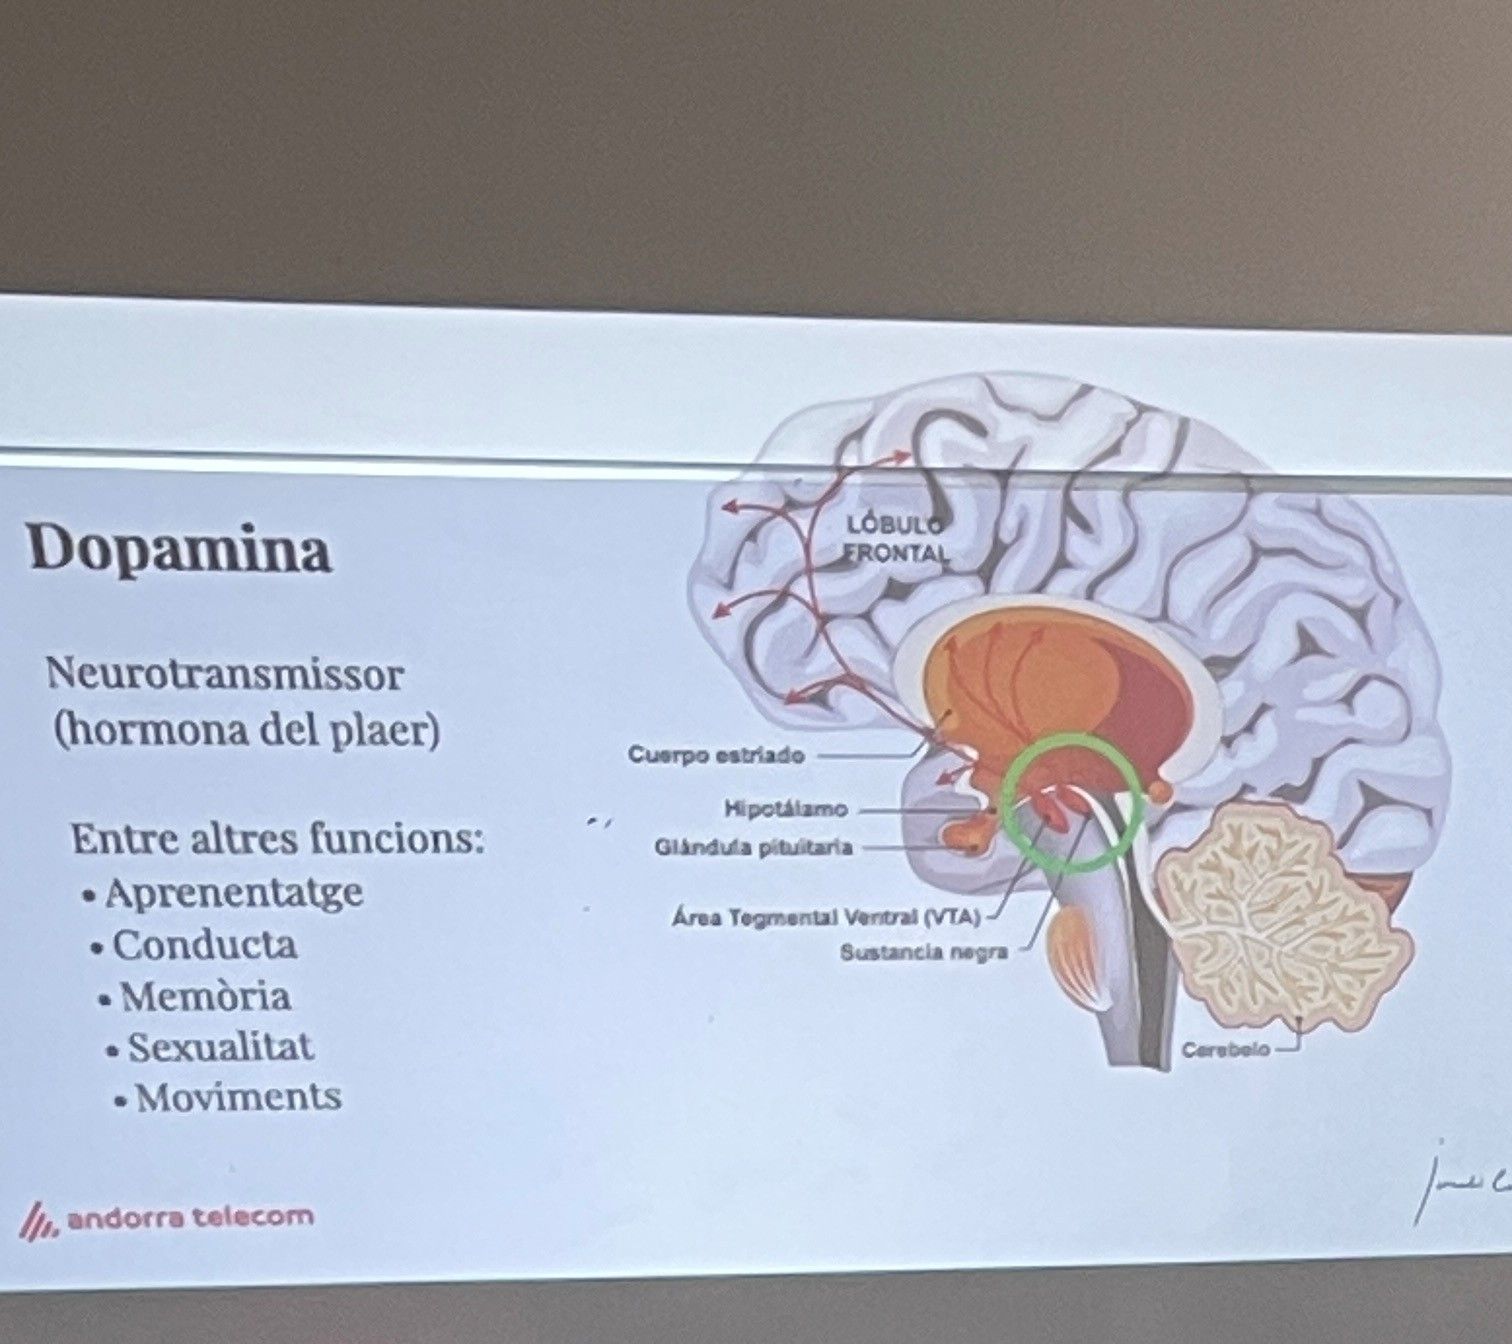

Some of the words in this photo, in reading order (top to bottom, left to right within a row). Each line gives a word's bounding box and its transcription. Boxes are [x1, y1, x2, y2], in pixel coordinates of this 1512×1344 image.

[848, 509, 945, 534] LÓBULO
[25, 521, 334, 581] Dopamina
[843, 543, 952, 563] FRONTAL
[46, 656, 406, 692] Neurotransmissor
[54, 708, 250, 752] (hormona
[260, 710, 320, 747] del
[330, 711, 440, 753] plaer)
[628, 744, 710, 768] Cuerpo
[716, 744, 806, 765] estriado
[724, 798, 849, 821] Hipotálamo
[71, 820, 180, 856] Entre
[191, 819, 299, 856] altres
[310, 819, 485, 856] funcions:
[655, 837, 753, 857] Glándula
[759, 837, 854, 860] pituitaria
[105, 877, 365, 914] Aprenentatge
[672, 904, 723, 927] Área
[728, 907, 839, 931] Tegmental
[843, 907, 919, 927] Ventral
[923, 907, 982, 930] (VTA)
[112, 927, 299, 961] Conducta
[840, 942, 944, 962] Sustancia
[950, 946, 1009, 965] negra
[119, 978, 293, 1013] Memòria
[128, 1030, 316, 1063] Sexualitat
[1182, 1041, 1272, 1059] Cerebelo
[134, 1081, 343, 1113] Moviments
[67, 1206, 185, 1231] andorra
[191, 1204, 315, 1229] telecom
